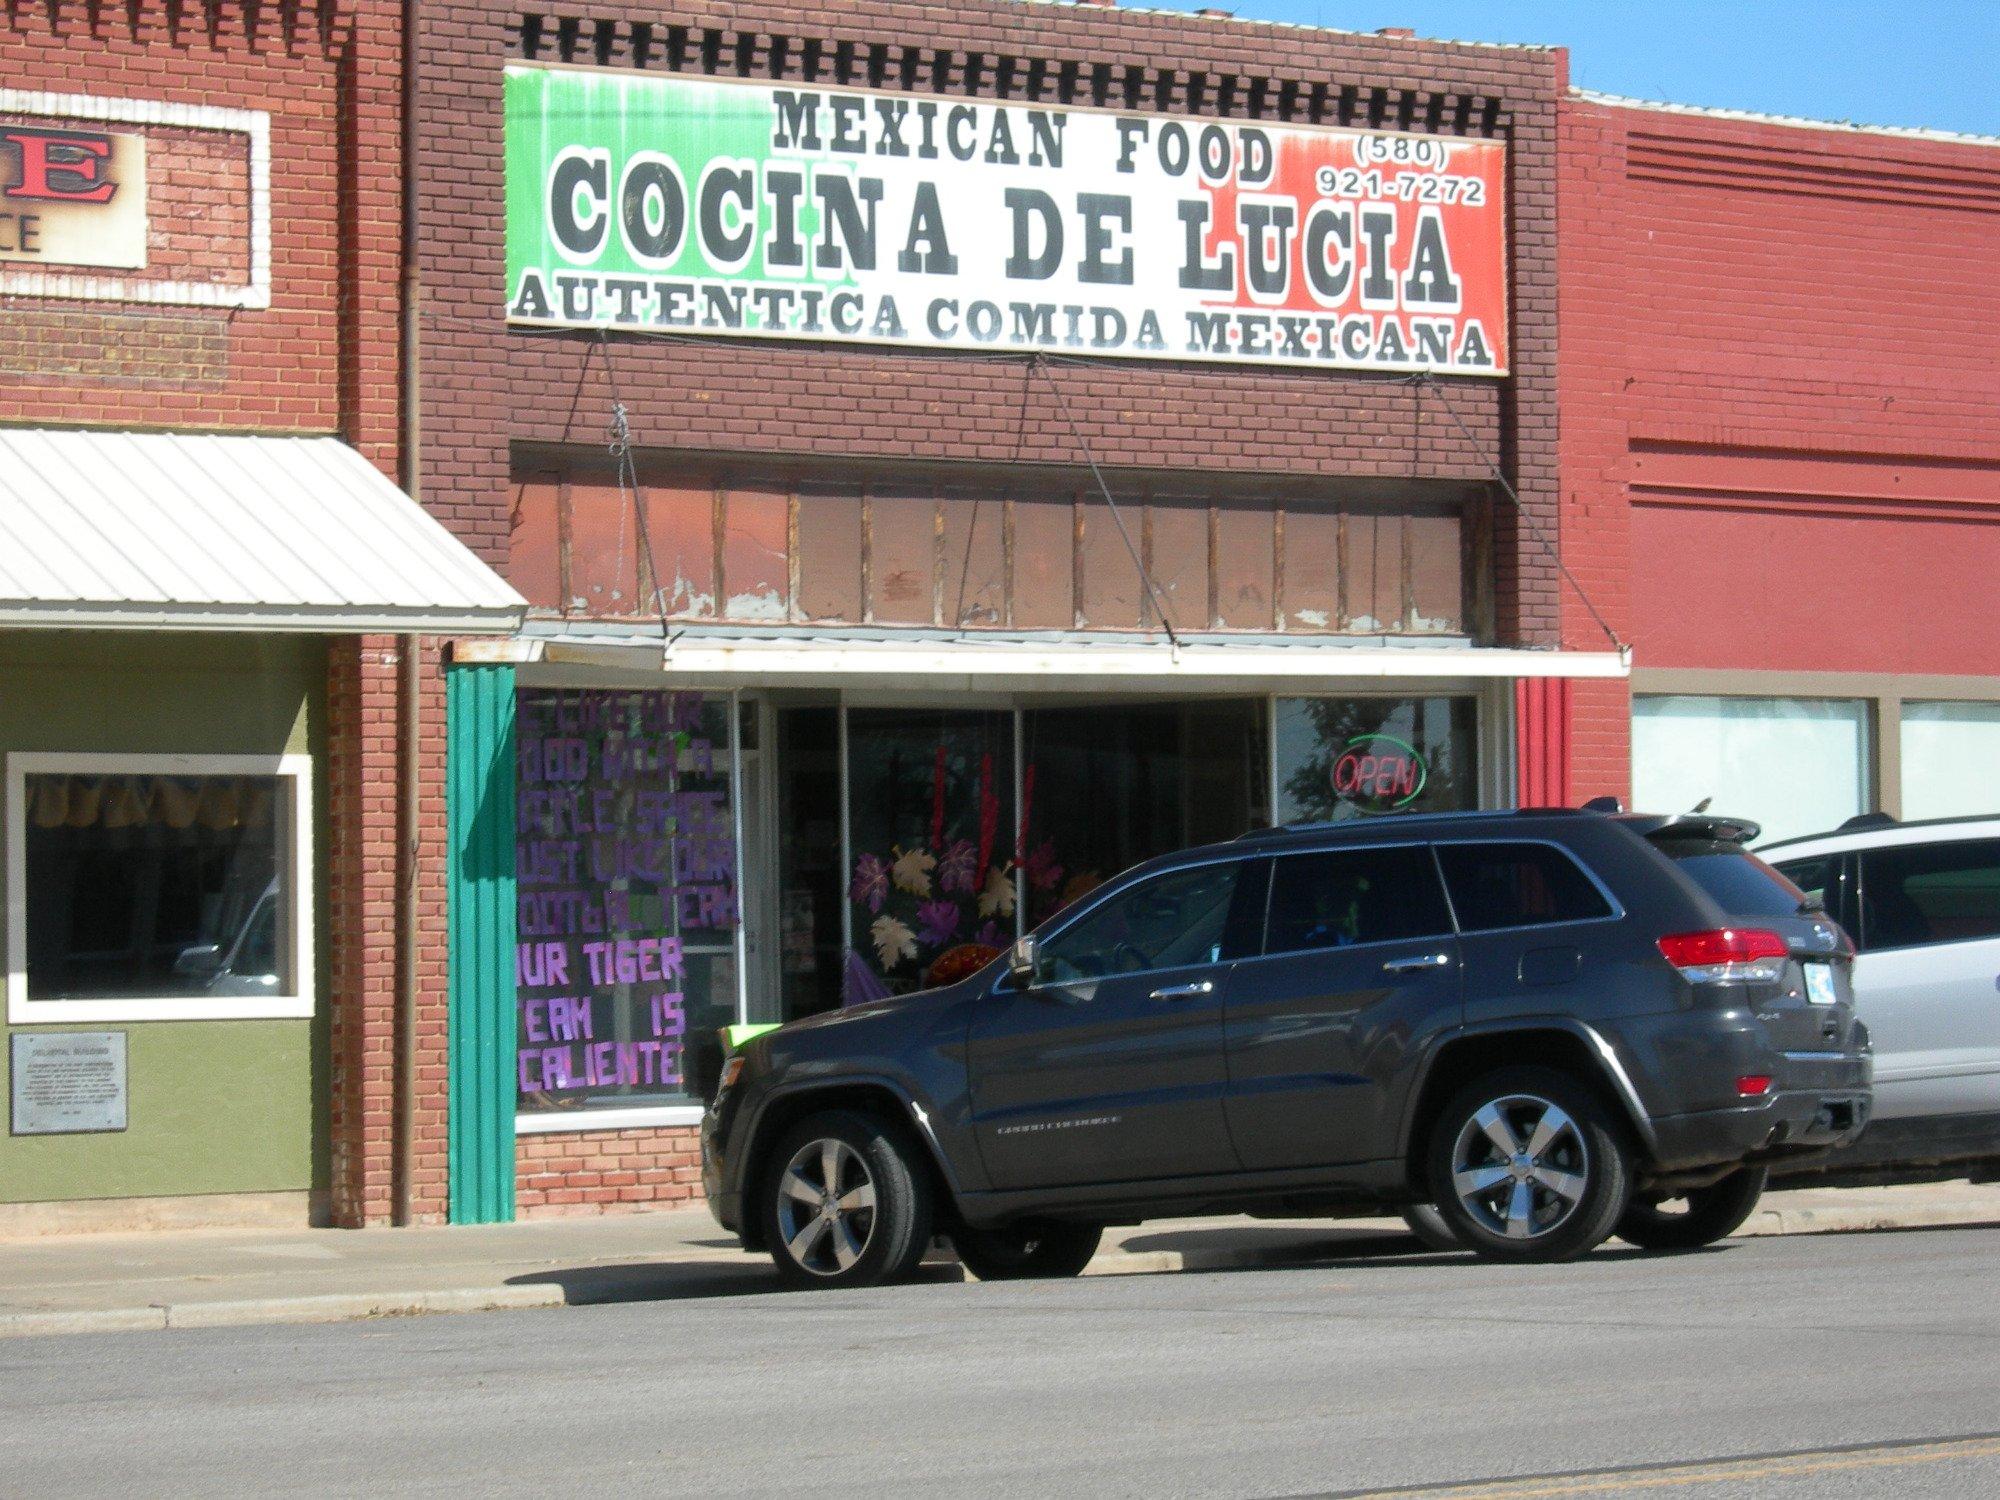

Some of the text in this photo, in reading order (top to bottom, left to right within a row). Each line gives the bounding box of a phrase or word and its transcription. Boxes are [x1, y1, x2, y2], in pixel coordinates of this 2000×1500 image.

[773, 90, 1273, 184] MEXICAN FOOD
[1356, 134, 1448, 168] (580)
[1319, 168, 1485, 204] 921-7272
[550, 156, 1459, 304] COCINA DE LUCIA
[511, 274, 1492, 366] AUTENTICA COMIDA MEXICANA
[519, 737, 588, 781] OOD
[1333, 754, 1418, 796] OPEN
[516, 840, 583, 884] UST
[517, 937, 686, 987] UR TIGER
[517, 992, 687, 1043] EAM IS
[518, 1040, 686, 1093] CALIENTE
